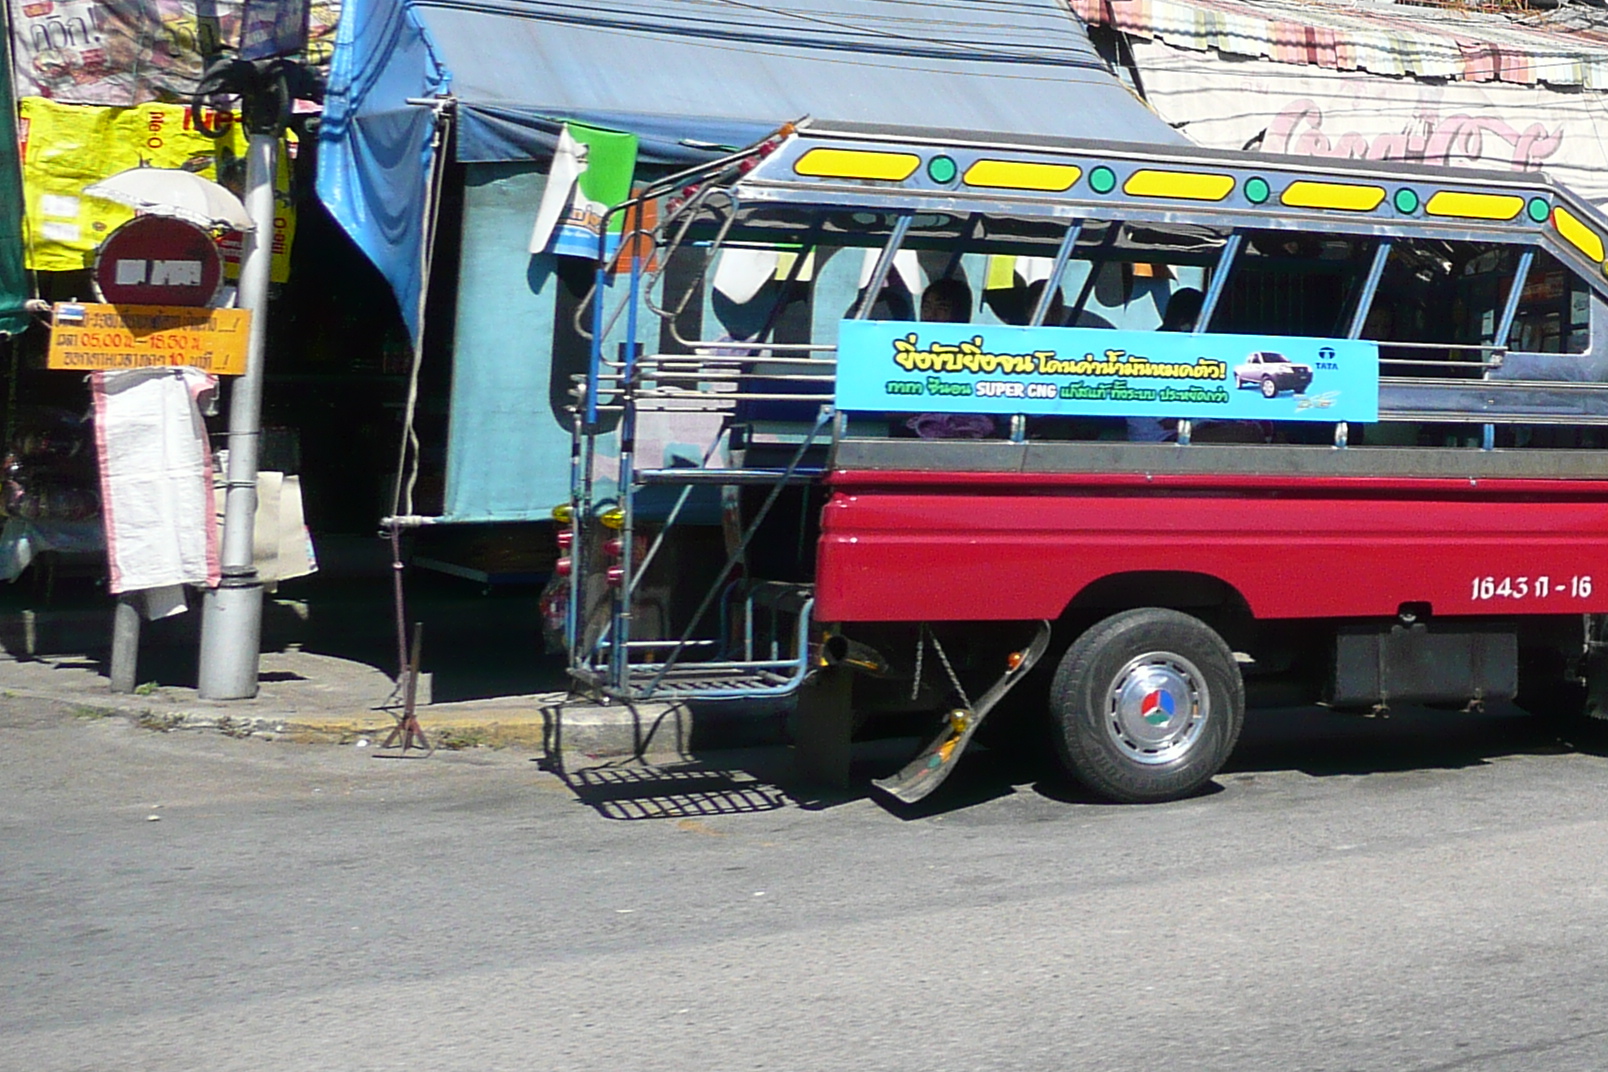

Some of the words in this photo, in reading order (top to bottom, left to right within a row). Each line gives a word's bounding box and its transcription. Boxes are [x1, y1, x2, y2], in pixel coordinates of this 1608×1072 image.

[169, 352, 185, 367] 10
[893, 333, 1034, 375] ยิ่งขับยิ่งจน
[1314, 361, 1339, 371] TATA
[974, 381, 1025, 398] SUPER
[1027, 383, 1057, 399] CNG
[1470, 575, 1529, 602] 1643
[1571, 575, 1592, 599] 16
